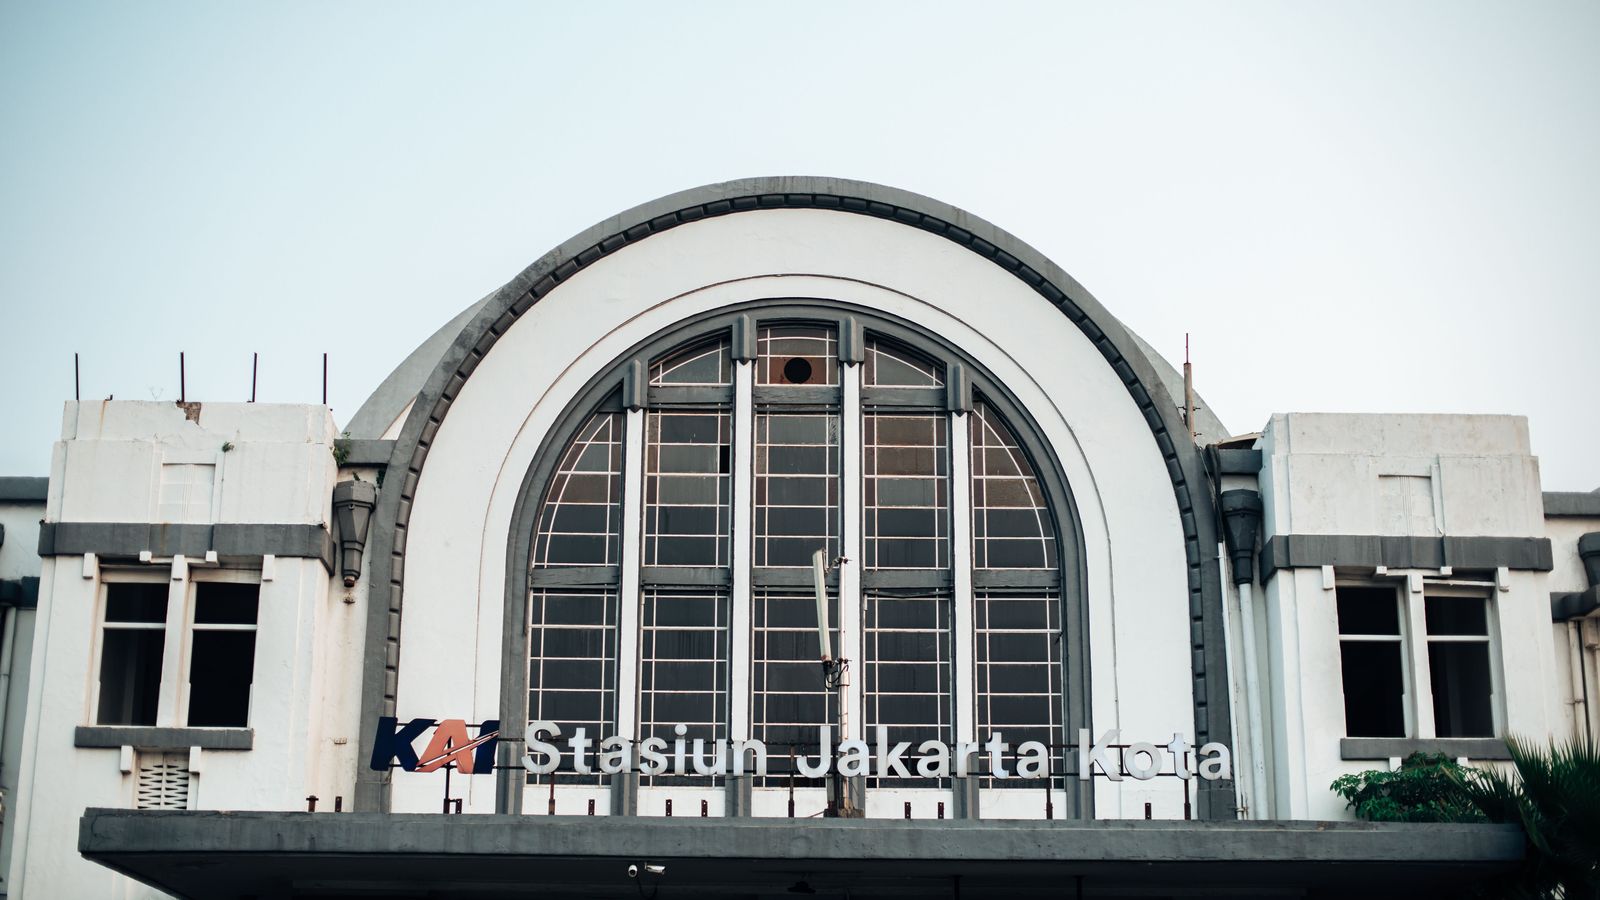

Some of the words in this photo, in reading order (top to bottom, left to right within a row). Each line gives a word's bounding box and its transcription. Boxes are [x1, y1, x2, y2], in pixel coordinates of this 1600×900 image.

[370, 716, 500, 774] KAI
[521, 720, 767, 777] Stasiun
[796, 725, 1049, 779] Jakarta
[1079, 728, 1232, 782] Kota
